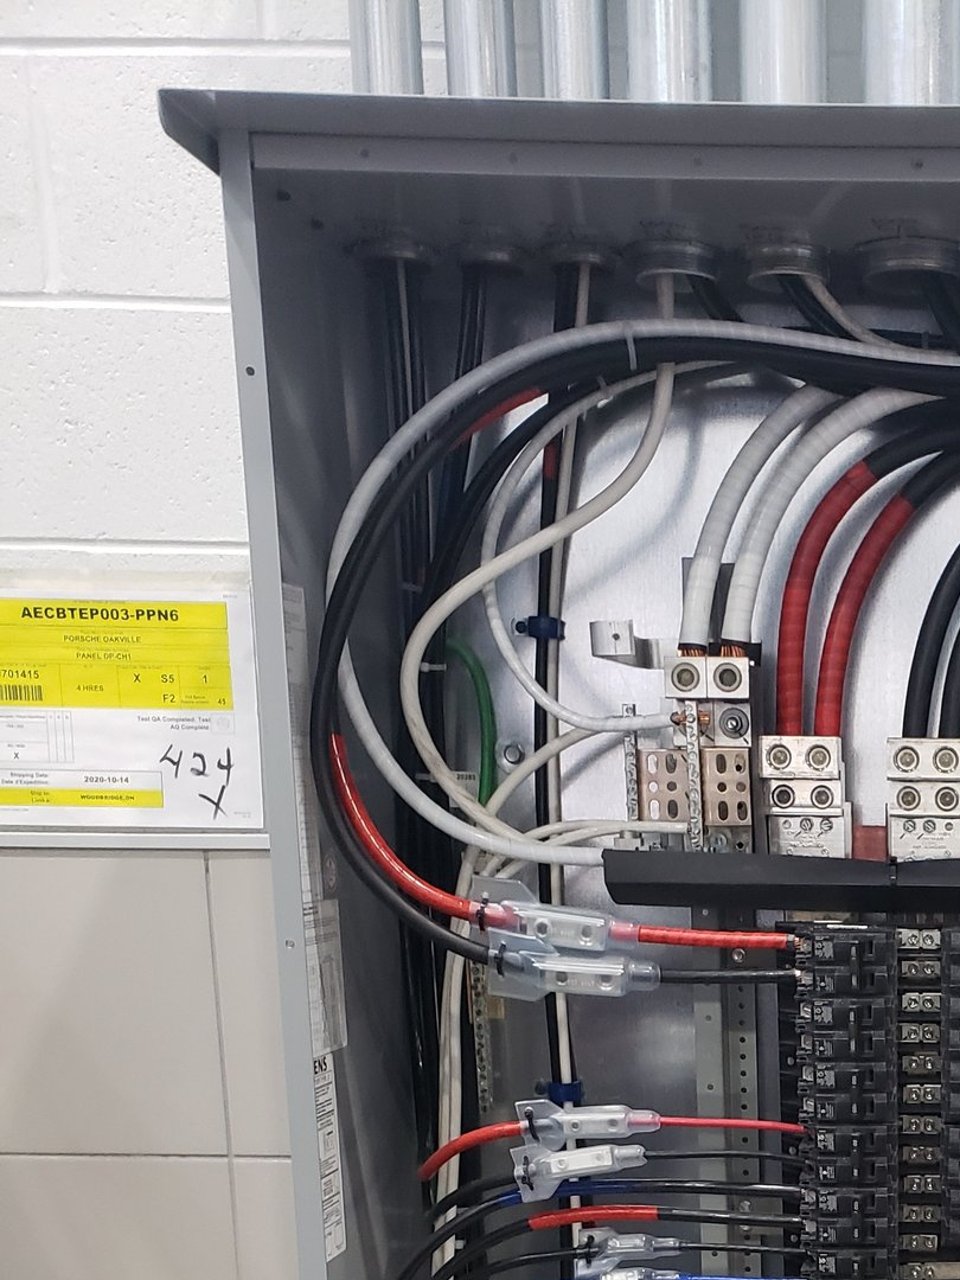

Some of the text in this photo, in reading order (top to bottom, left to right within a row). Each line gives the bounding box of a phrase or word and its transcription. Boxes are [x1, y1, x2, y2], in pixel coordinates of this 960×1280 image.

[21, 606, 179, 621] AECBTEP003-PPN6
[63, 635, 141, 644] PORSCHE OAKVILLE
[76, 652, 102, 660] PANEL
[0, 669, 40, 680] 701415
[133, 673, 141, 683] X
[160, 674, 175, 684] S5
[202, 675, 208, 684] 1
[162, 694, 176, 703] F2
[160, 744, 235, 787] 424
[84, 776, 129, 784] 2020-10-14
[313, 1056, 328, 1075] ENS
